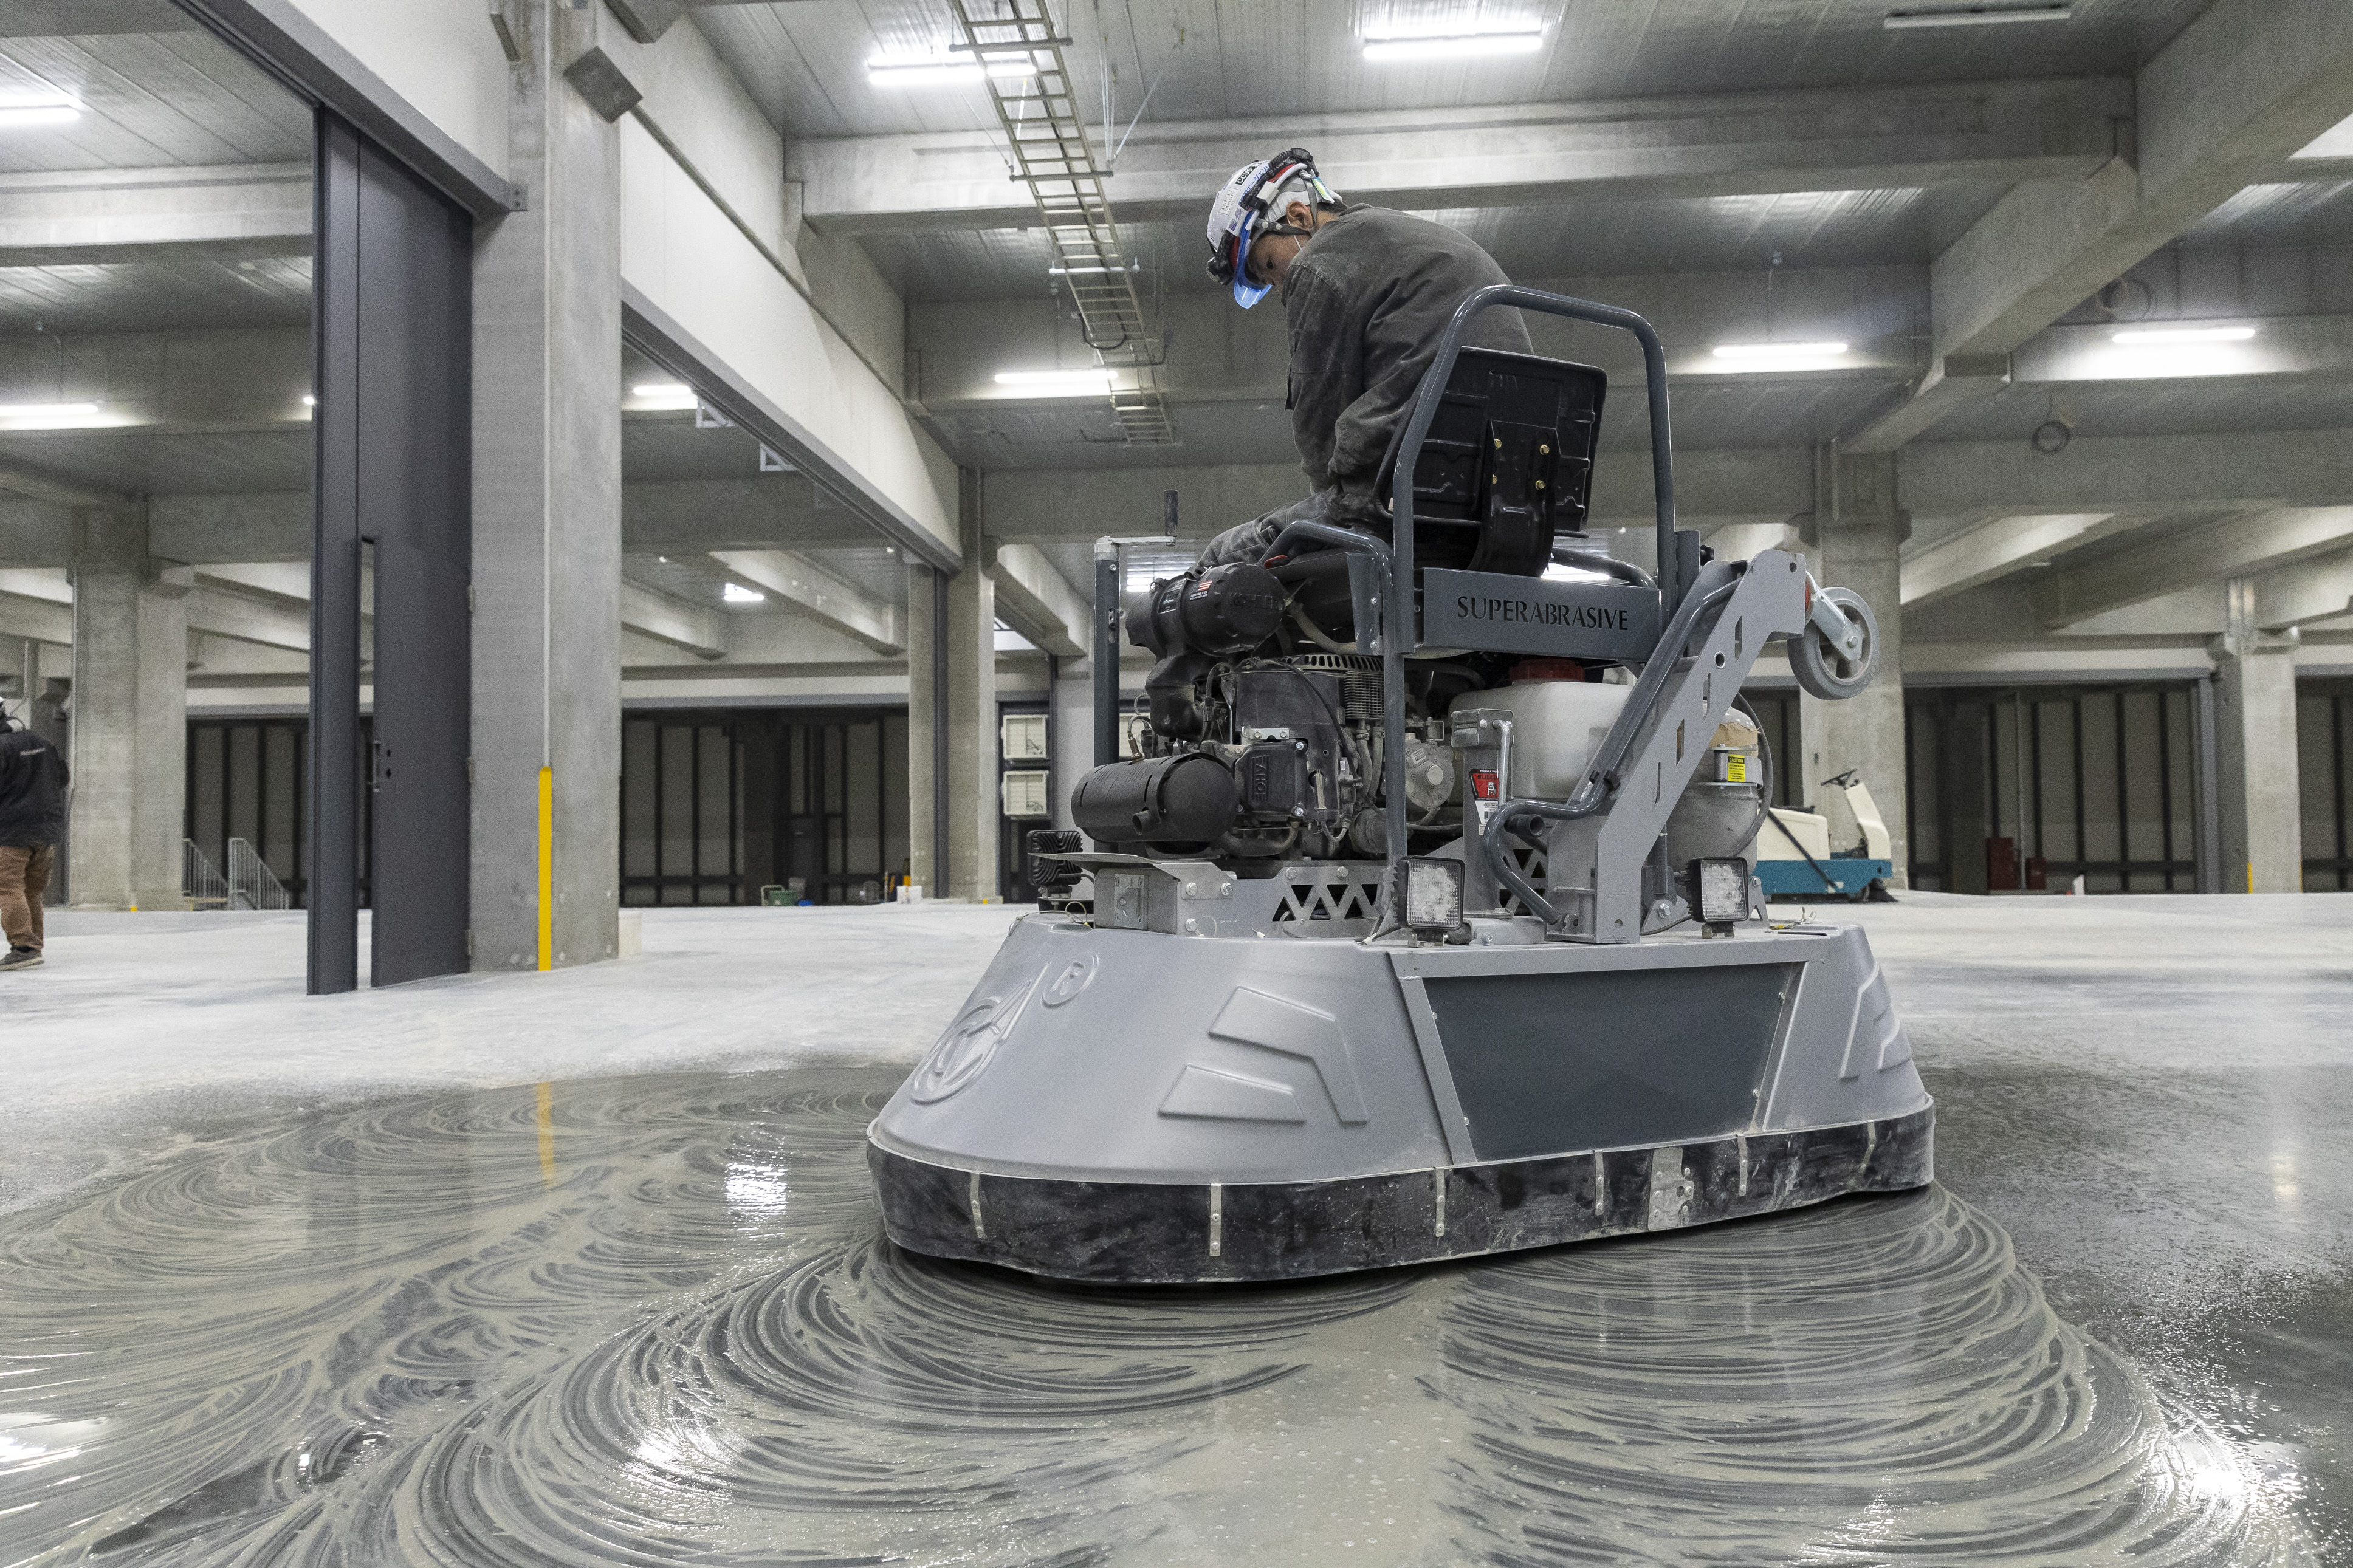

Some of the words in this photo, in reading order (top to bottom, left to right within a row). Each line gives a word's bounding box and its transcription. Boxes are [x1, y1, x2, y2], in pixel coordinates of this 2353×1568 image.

[1237, 166, 1254, 183] CCUS
[1225, 190, 1237, 213] QUALITY
[1229, 592, 1281, 609] KOHLER
[1457, 596, 1628, 631] SUPERABRASIVE
